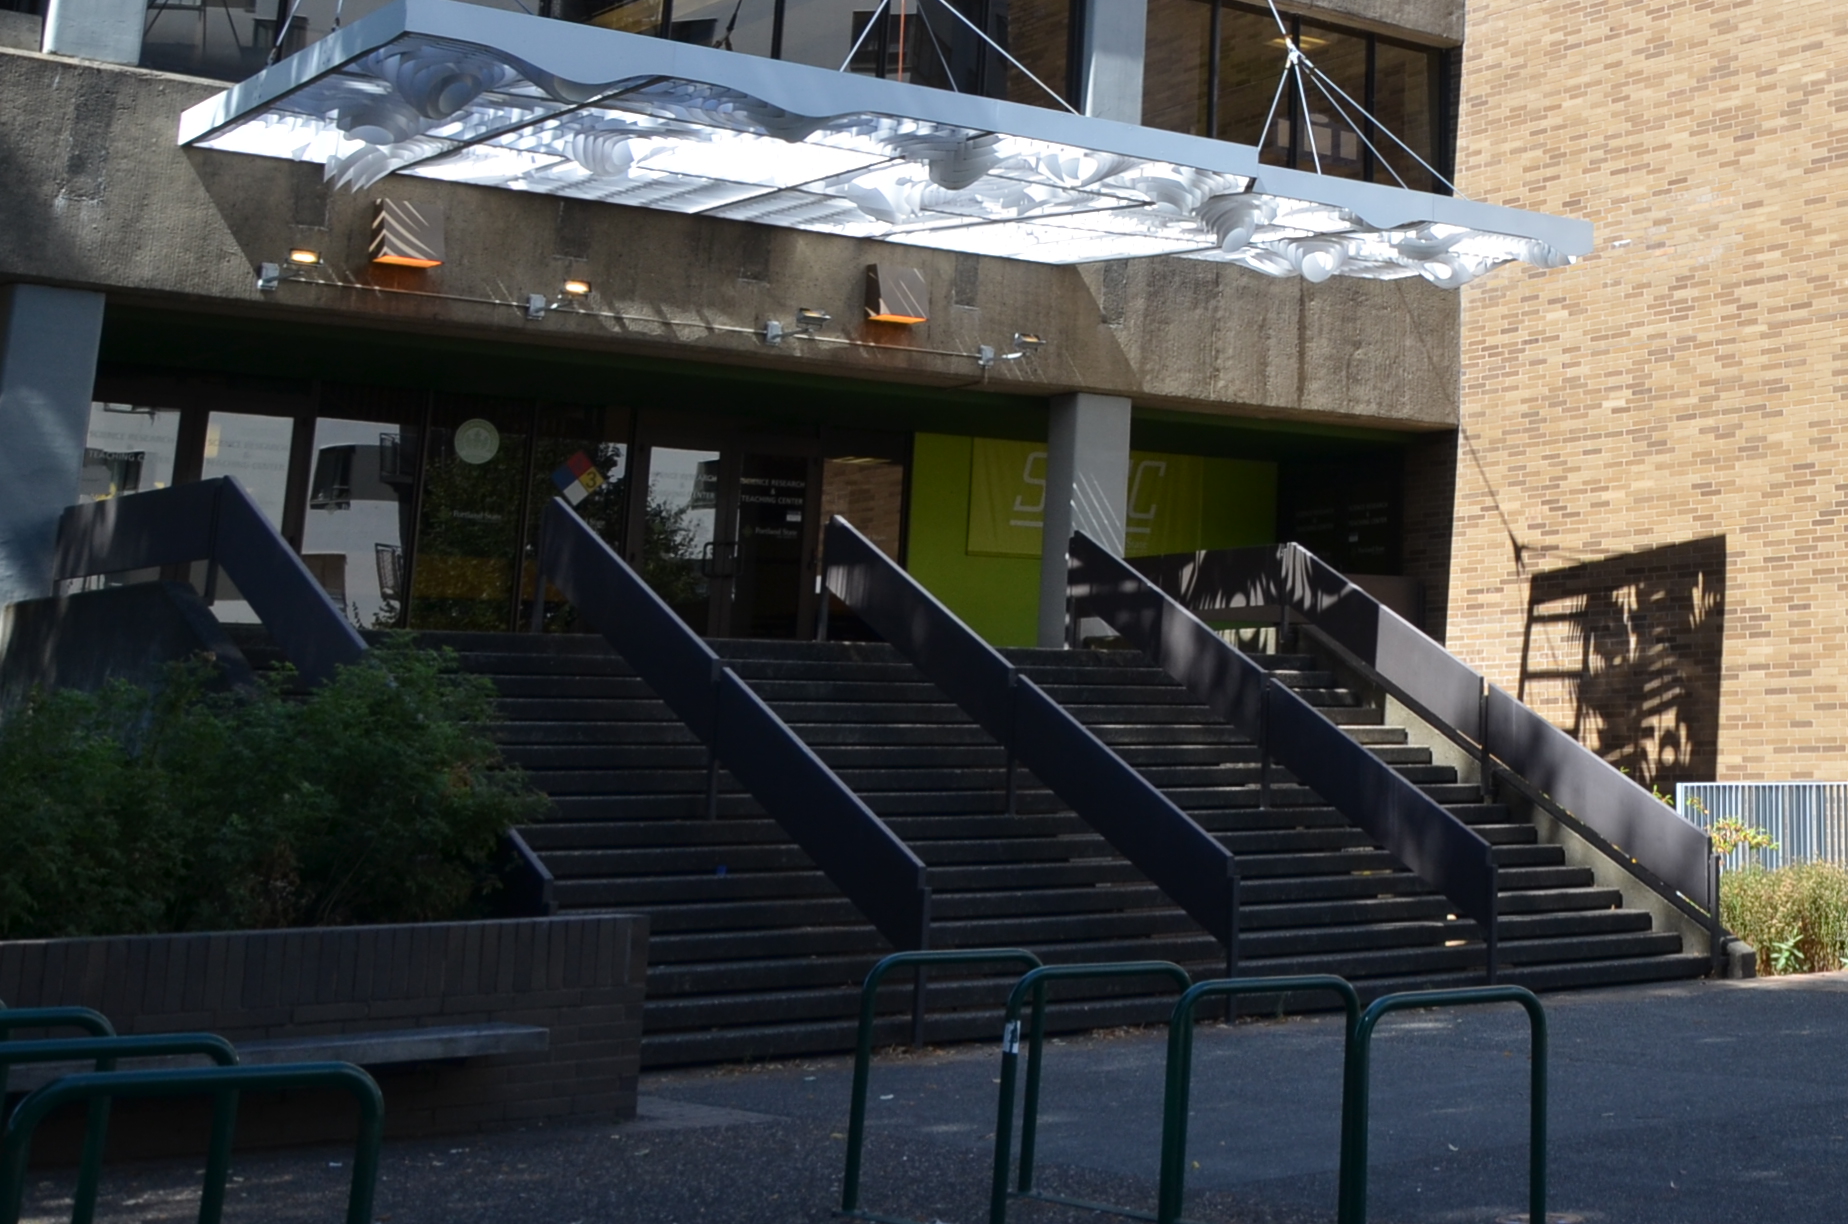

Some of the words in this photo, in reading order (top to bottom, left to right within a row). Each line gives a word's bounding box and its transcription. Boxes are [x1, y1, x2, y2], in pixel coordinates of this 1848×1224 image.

[88, 451, 135, 462] TEACHING
[585, 471, 597, 489] 3
[771, 479, 805, 487] RESEARCH
[741, 495, 776, 504] TEACHING
[755, 527, 781, 535] Portland
